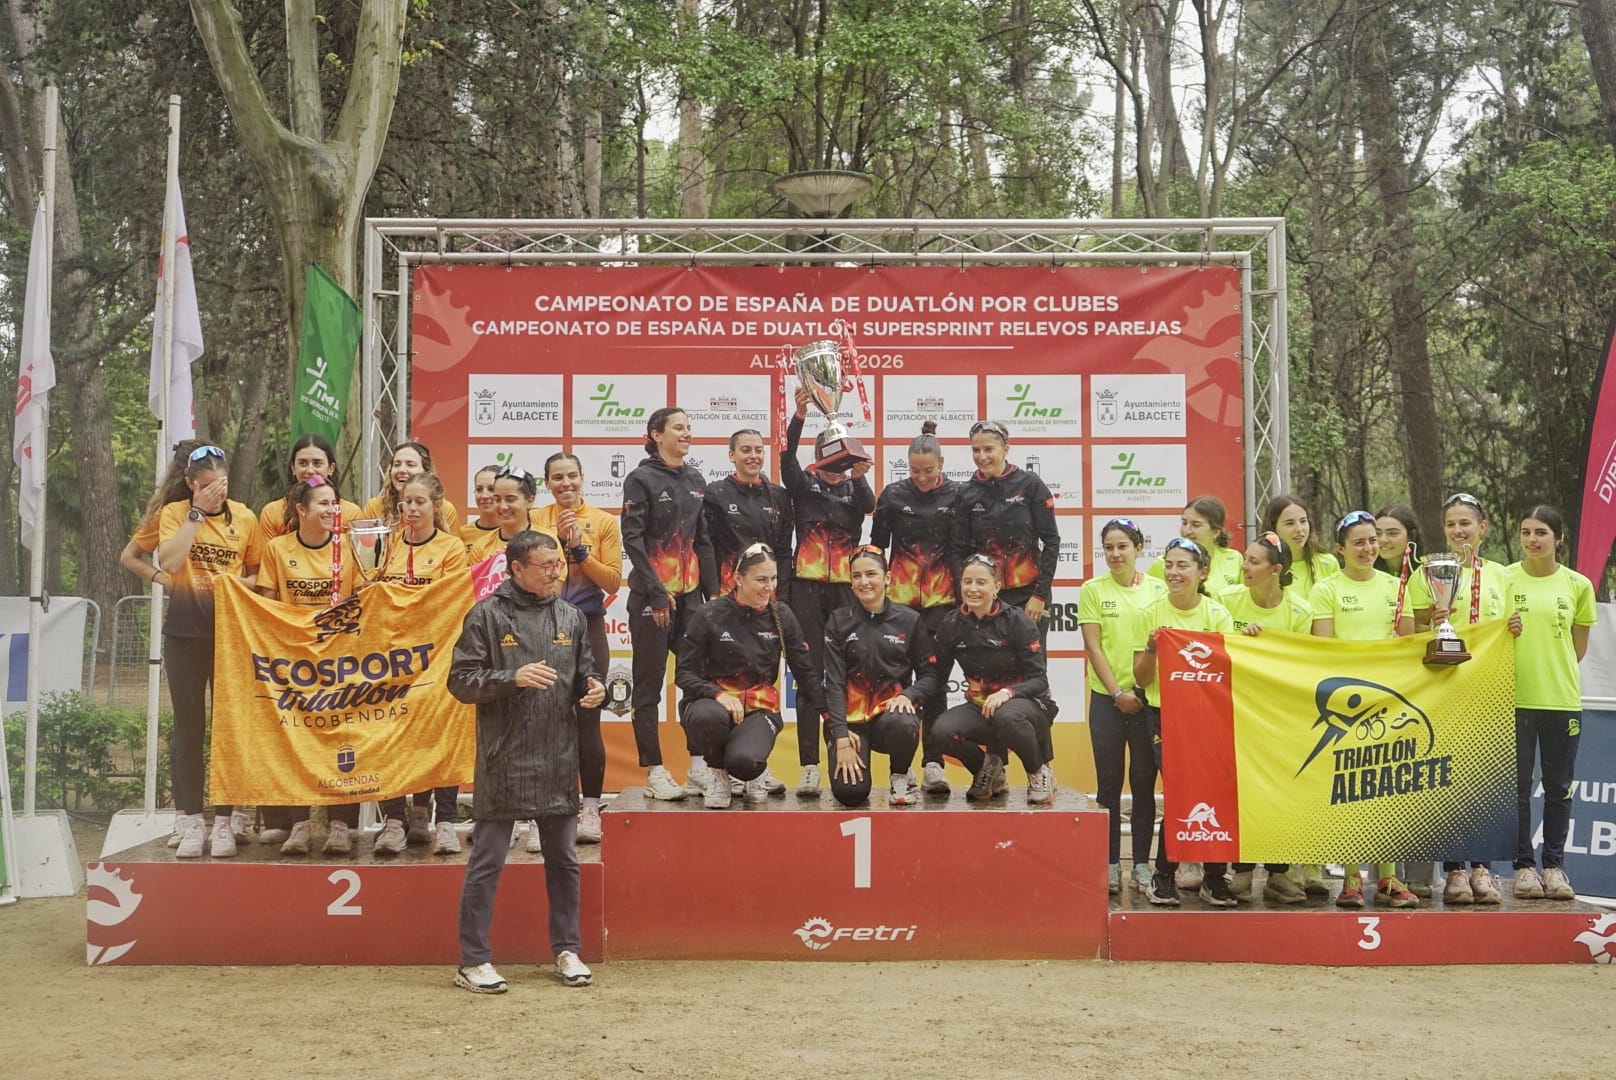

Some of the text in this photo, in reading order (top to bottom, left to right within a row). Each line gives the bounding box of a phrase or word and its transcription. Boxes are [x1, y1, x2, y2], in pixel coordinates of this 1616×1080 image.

[534, 292, 1119, 313] CAMPEONATO DE ESPAÑA DE DUATLÓN POR CLUBES
[472, 320, 610, 336] CAMPEONATO
[616, 321, 642, 336] DE
[647, 317, 726, 336] ESPAÑA
[731, 321, 758, 336] DE
[863, 321, 994, 337] SUPERSPRINT
[999, 321, 1089, 336] RELEVOS
[1094, 320, 1182, 336] PAREJAS
[857, 354, 904, 369] 2026
[502, 400, 559, 409] Ayuntamiento
[1124, 400, 1181, 409] Ayuntamiento
[502, 411, 559, 421] ALBACETE
[686, 412, 719, 420] PUTACIÓN
[1124, 411, 1181, 421] ALBACETE
[190, 544, 238, 560] COSPORT
[251, 642, 434, 687] ECOSPORT
[279, 702, 409, 728] ALCOBENDAS
[1332, 736, 1417, 772] TRIATLÓN
[318, 773, 380, 789] ALCOBENDAS
[1330, 755, 1453, 806] ALBACETE
[1176, 829, 1233, 842] austral
[839, 816, 872, 888] 1
[326, 868, 363, 916] 2
[1357, 916, 1381, 950] 3
